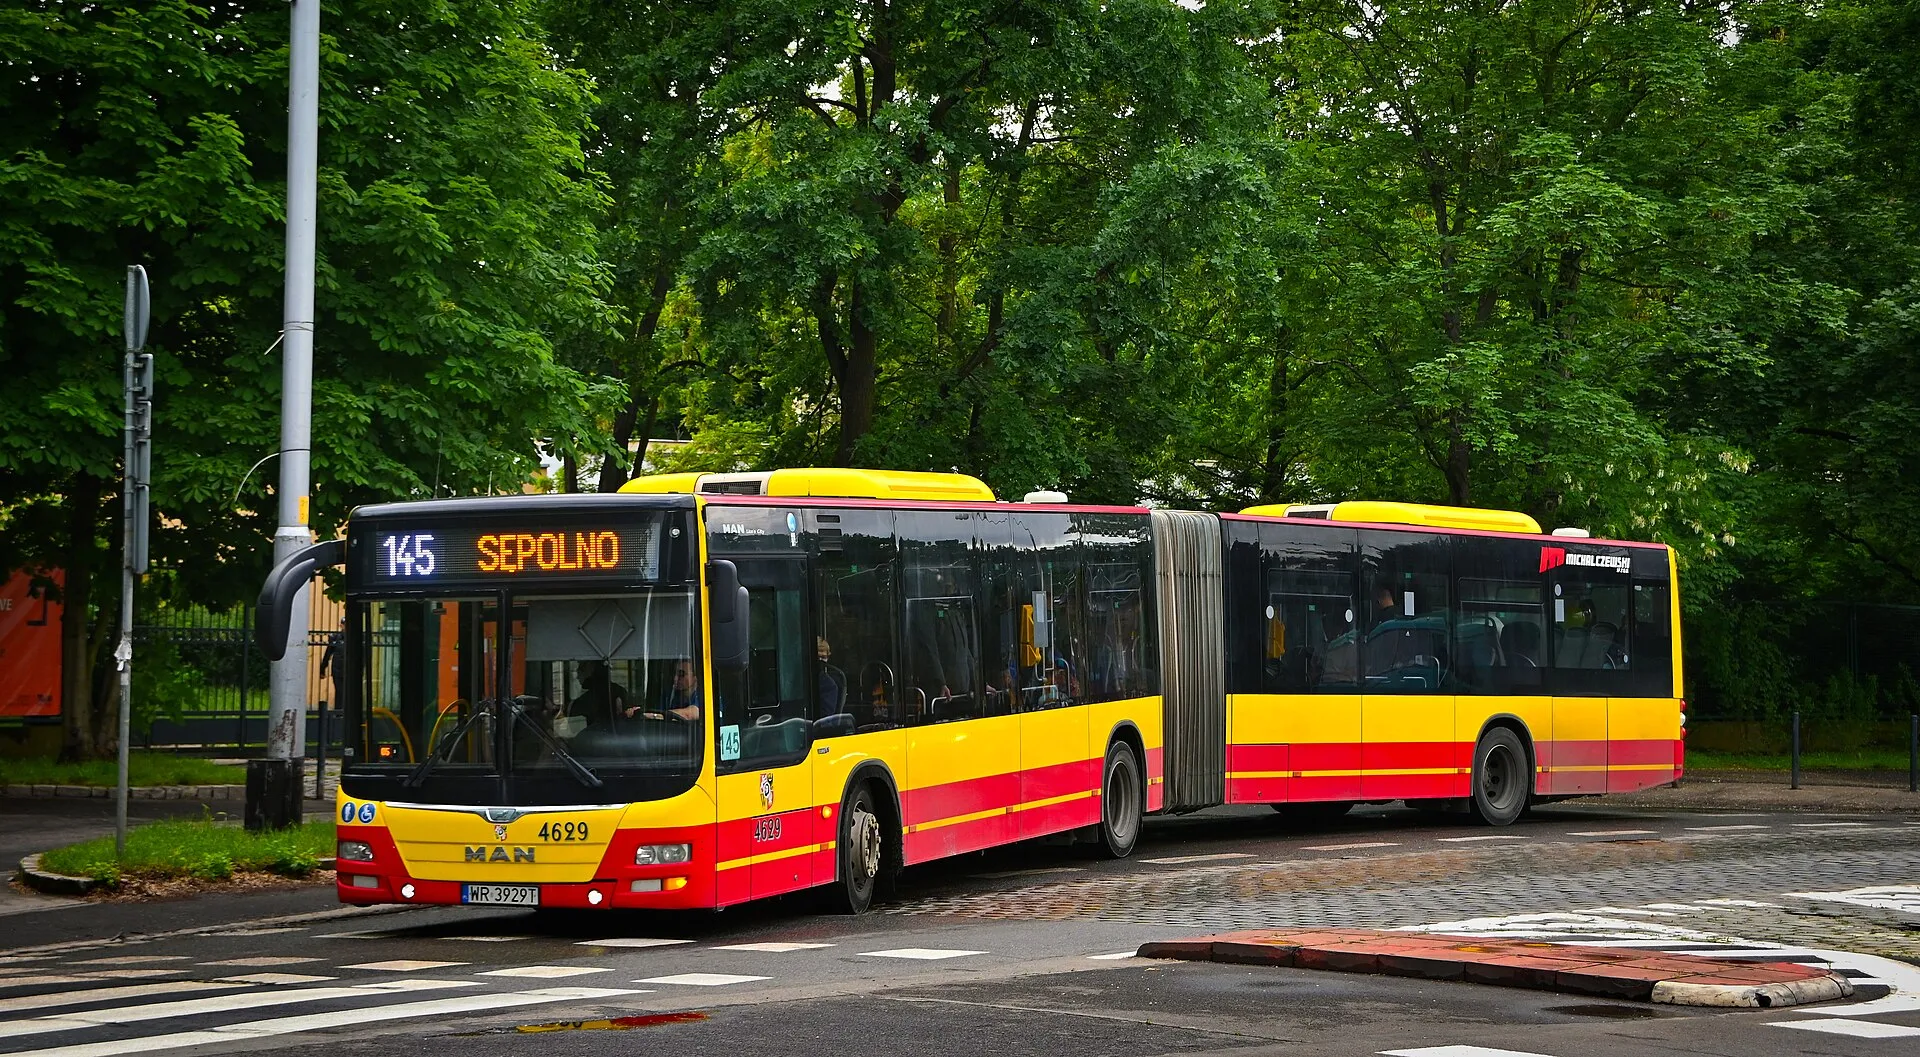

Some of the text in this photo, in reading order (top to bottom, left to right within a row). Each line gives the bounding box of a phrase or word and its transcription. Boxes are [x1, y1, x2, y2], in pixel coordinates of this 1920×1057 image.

[722, 523, 745, 534] MAN
[383, 531, 619, 576] 145 SĘPOLNO
[1565, 554, 1630, 568] MICHALCZEWSKI
[721, 731, 740, 755] 145
[537, 821, 589, 842] 4629
[754, 817, 782, 842] 4629
[464, 845, 536, 863] MAN
[470, 886, 537, 904] WR 3929T
